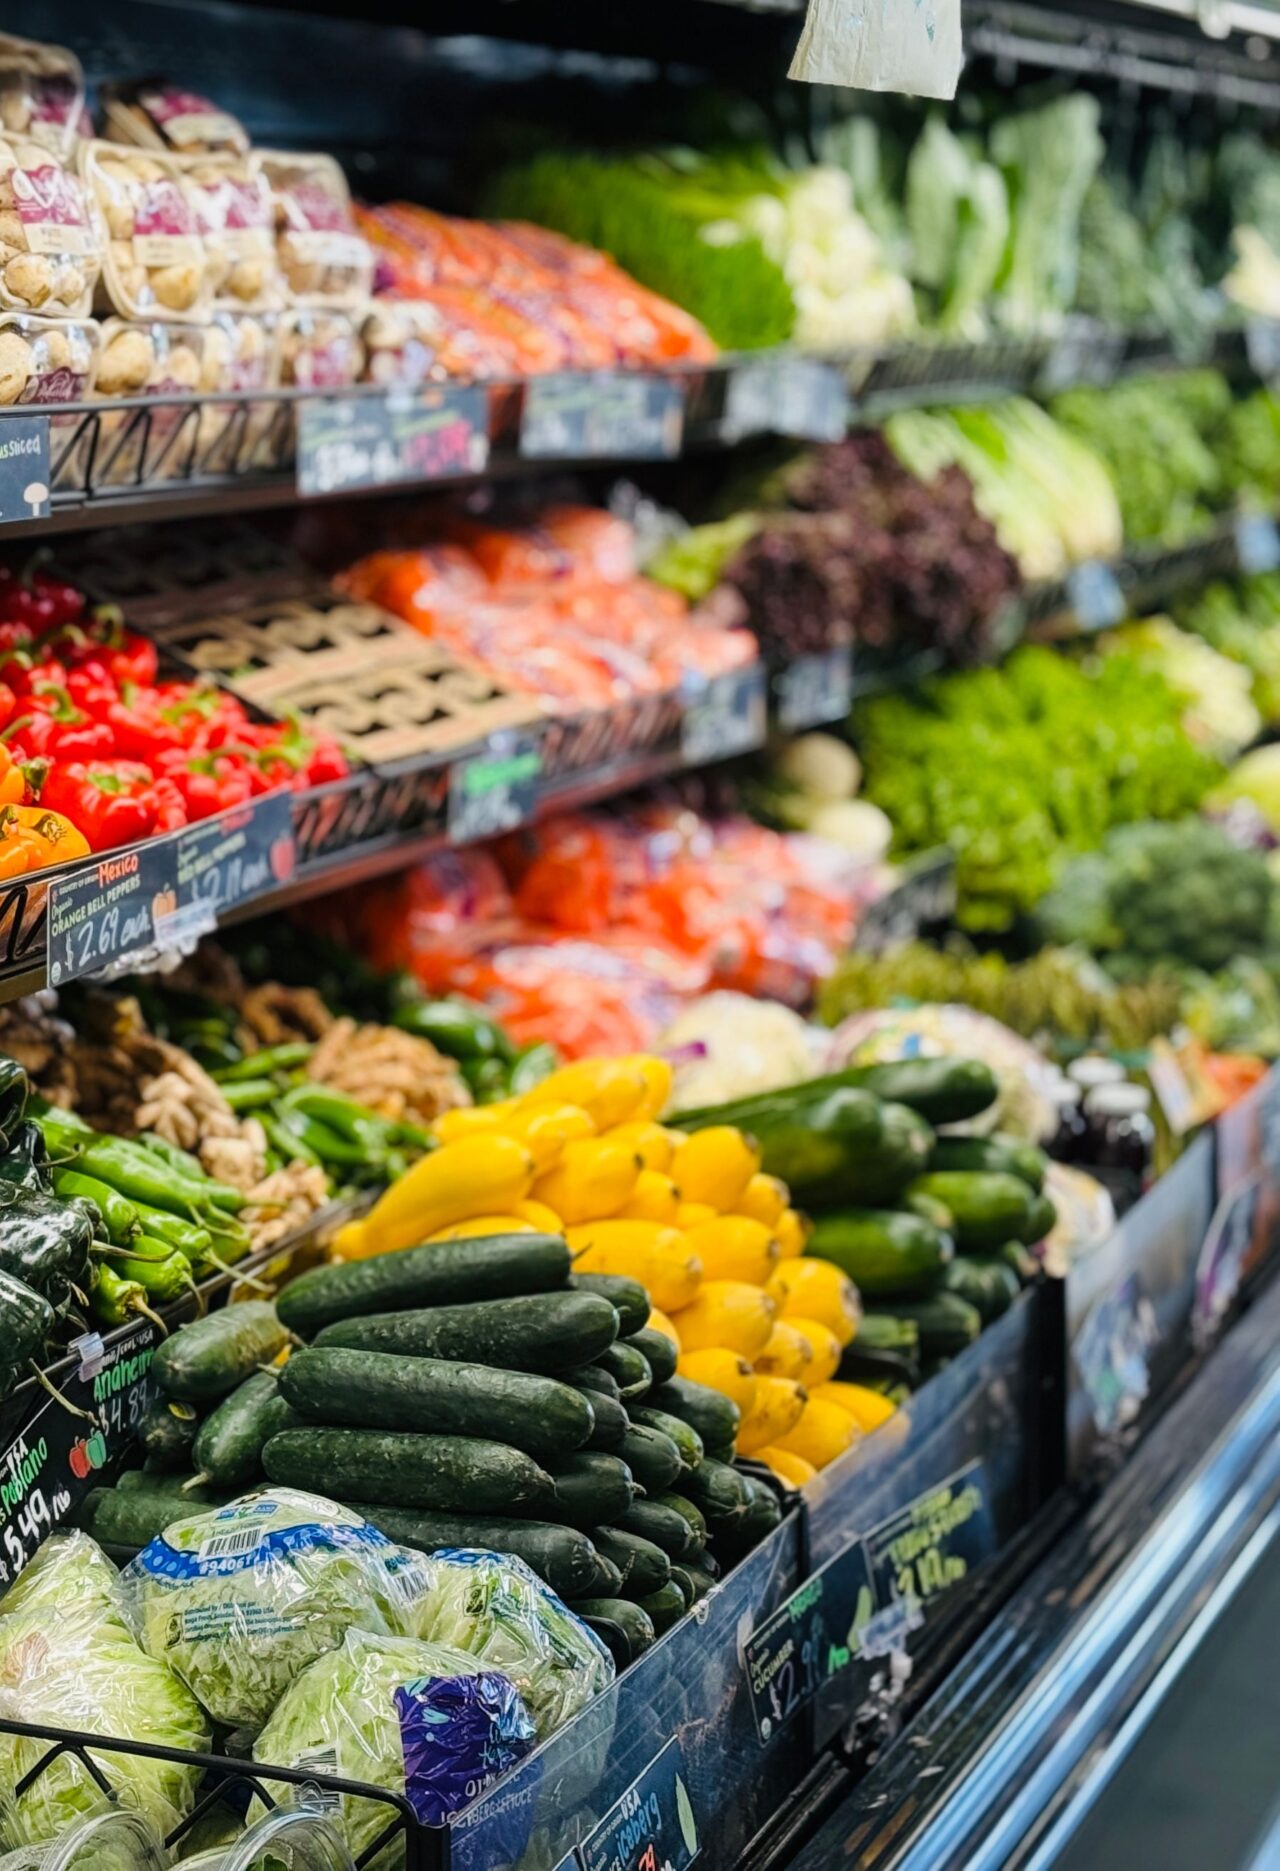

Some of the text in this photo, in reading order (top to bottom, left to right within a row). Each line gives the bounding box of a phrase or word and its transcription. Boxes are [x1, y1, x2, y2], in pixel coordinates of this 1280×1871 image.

[99, 854, 139, 889] Mexico
[51, 873, 141, 937] ORANGE BELL PEPPERS
[752, 1638, 795, 1695] CUCUMBER
[620, 1788, 642, 1821] USA
